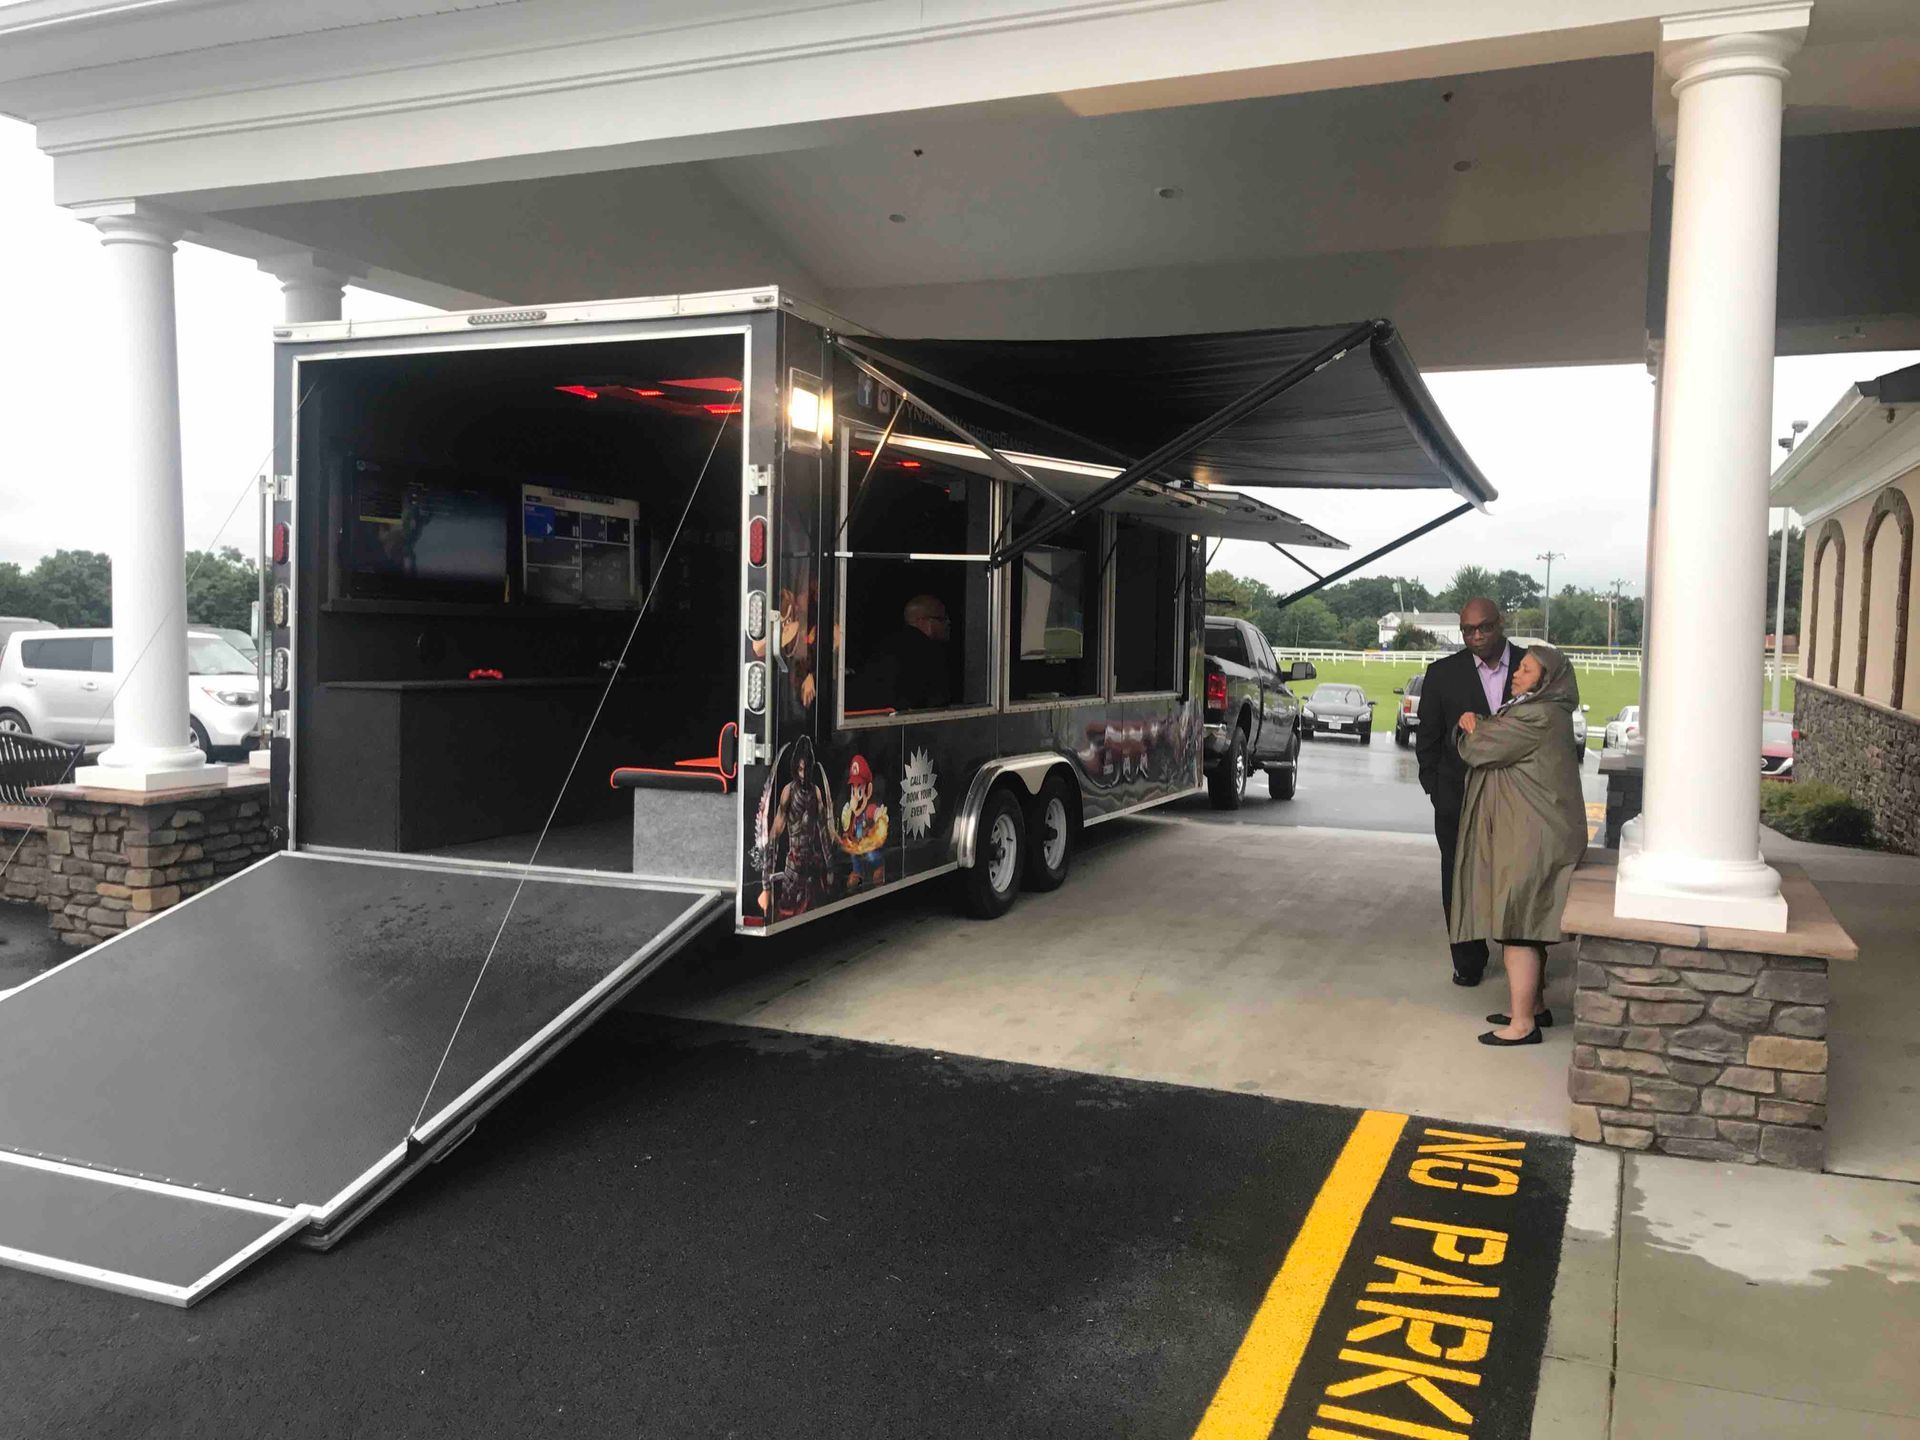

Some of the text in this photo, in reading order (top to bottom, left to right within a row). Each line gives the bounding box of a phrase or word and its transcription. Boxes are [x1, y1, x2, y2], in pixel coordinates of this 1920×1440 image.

[906, 788, 931, 803] BOOK YOUR
[910, 773, 929, 786] CALL TO
[1408, 1128, 1526, 1196] NO
[1306, 1215, 1509, 1440] PARKI
